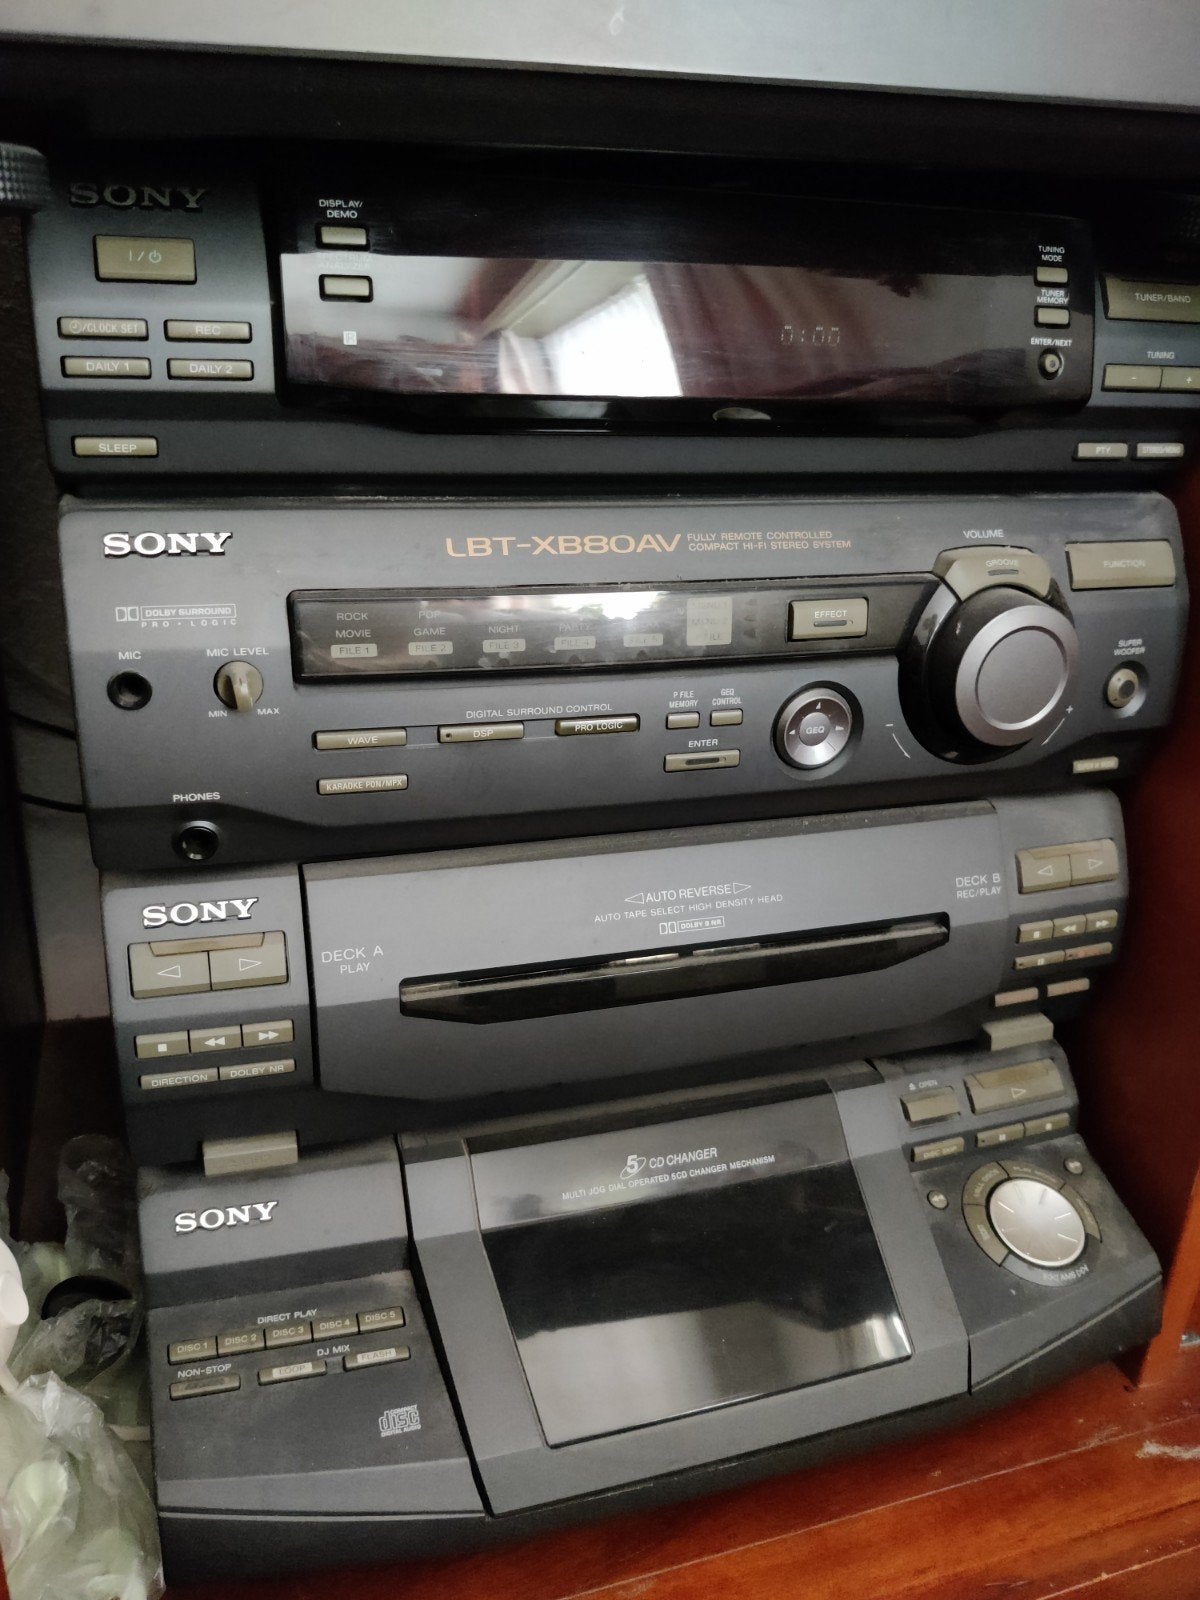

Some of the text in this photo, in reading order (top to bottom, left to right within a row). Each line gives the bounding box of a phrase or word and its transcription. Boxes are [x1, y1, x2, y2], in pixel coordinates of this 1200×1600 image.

[69, 182, 209, 209] SONY
[319, 199, 363, 208] DISPLAY/
[327, 210, 357, 219] DEMO
[1038, 245, 1065, 254] TUNING
[1041, 254, 1062, 262] MODE
[1041, 289, 1064, 297] TUNER
[1135, 292, 1191, 303] TUNER/BAND
[1037, 297, 1069, 305] MEMORY
[195, 325, 222, 336] REC
[1030, 337, 1072, 347] ENTER/NEXT
[1146, 351, 1175, 359] TUNING
[86, 361, 130, 371] DAILY 1
[189, 364, 233, 374] DAILY 2
[98, 443, 137, 453] SLEEP
[687, 531, 832, 542] FULLY REMOTE CONTROLLED
[963, 529, 1004, 539] VOLUME
[103, 532, 233, 557] SONY
[446, 533, 681, 558] LBT-XB80AV
[688, 540, 851, 551] COMPACT HI-FI STEREO SYSTEM
[985, 558, 1019, 568] GROOVE
[145, 607, 232, 617] DOLBY SURROUND
[336, 612, 369, 621] ROCK
[418, 610, 441, 620] POP
[814, 609, 848, 619] EFFECT
[335, 629, 372, 638] MOVIE
[413, 627, 446, 637] GAME
[488, 624, 520, 634] NIGHT
[489, 641, 513, 650] FILE
[1117, 638, 1143, 648] SUPER
[206, 647, 269, 657] MIC LEVEL
[339, 647, 362, 656] FILE
[415, 644, 446, 653] FILE 2
[118, 651, 142, 661] MIC
[680, 690, 695, 699] FILE
[668, 699, 699, 709] MEMORY
[711, 696, 742, 706] CONTROL
[208, 710, 228, 718] MIN
[257, 707, 280, 716] MAX
[466, 703, 613, 719] DIGITAL SURROUND CONTROL
[574, 721, 624, 732] PRO LOGIC
[805, 725, 825, 735] GEQ
[472, 729, 494, 739] DSP
[347, 735, 379, 745] WAVE
[688, 738, 719, 748] ENTER
[326, 781, 363, 792] KARAOKE
[172, 791, 221, 803] PHONES
[955, 872, 1001, 888] DECK B
[646, 884, 732, 903] AUTO REVERSE
[956, 886, 1002, 899] REC/PLAY
[142, 897, 259, 928] SONY
[594, 894, 784, 923] AUTO TAPE SELECT HIGH DENSITY HEAD
[321, 945, 384, 964] DECK A
[339, 962, 372, 975] PLAY
[230, 1064, 284, 1078] DOLBY NR
[151, 1074, 208, 1087] DIRECTION
[625, 1147, 719, 1173] 5 CD CHANGER
[562, 1188, 587, 1200] MULTI
[588, 1186, 606, 1196] JOG
[608, 1182, 627, 1192] DIAL
[628, 1174, 670, 1189] OPERATED
[689, 1164, 728, 1178] CHANGER
[729, 1154, 776, 1170] MECHANISM
[174, 1201, 278, 1233] SONY
[257, 1308, 318, 1325] DIRECT PLAY
[365, 1313, 388, 1323] DISC
[319, 1318, 351, 1331] DISC 4
[272, 1326, 305, 1338] DISC 3
[224, 1334, 257, 1346] DISC 2
[176, 1343, 200, 1354] DISC
[316, 1344, 351, 1357] DJ MIX
[177, 1363, 232, 1378] NON-STOP
